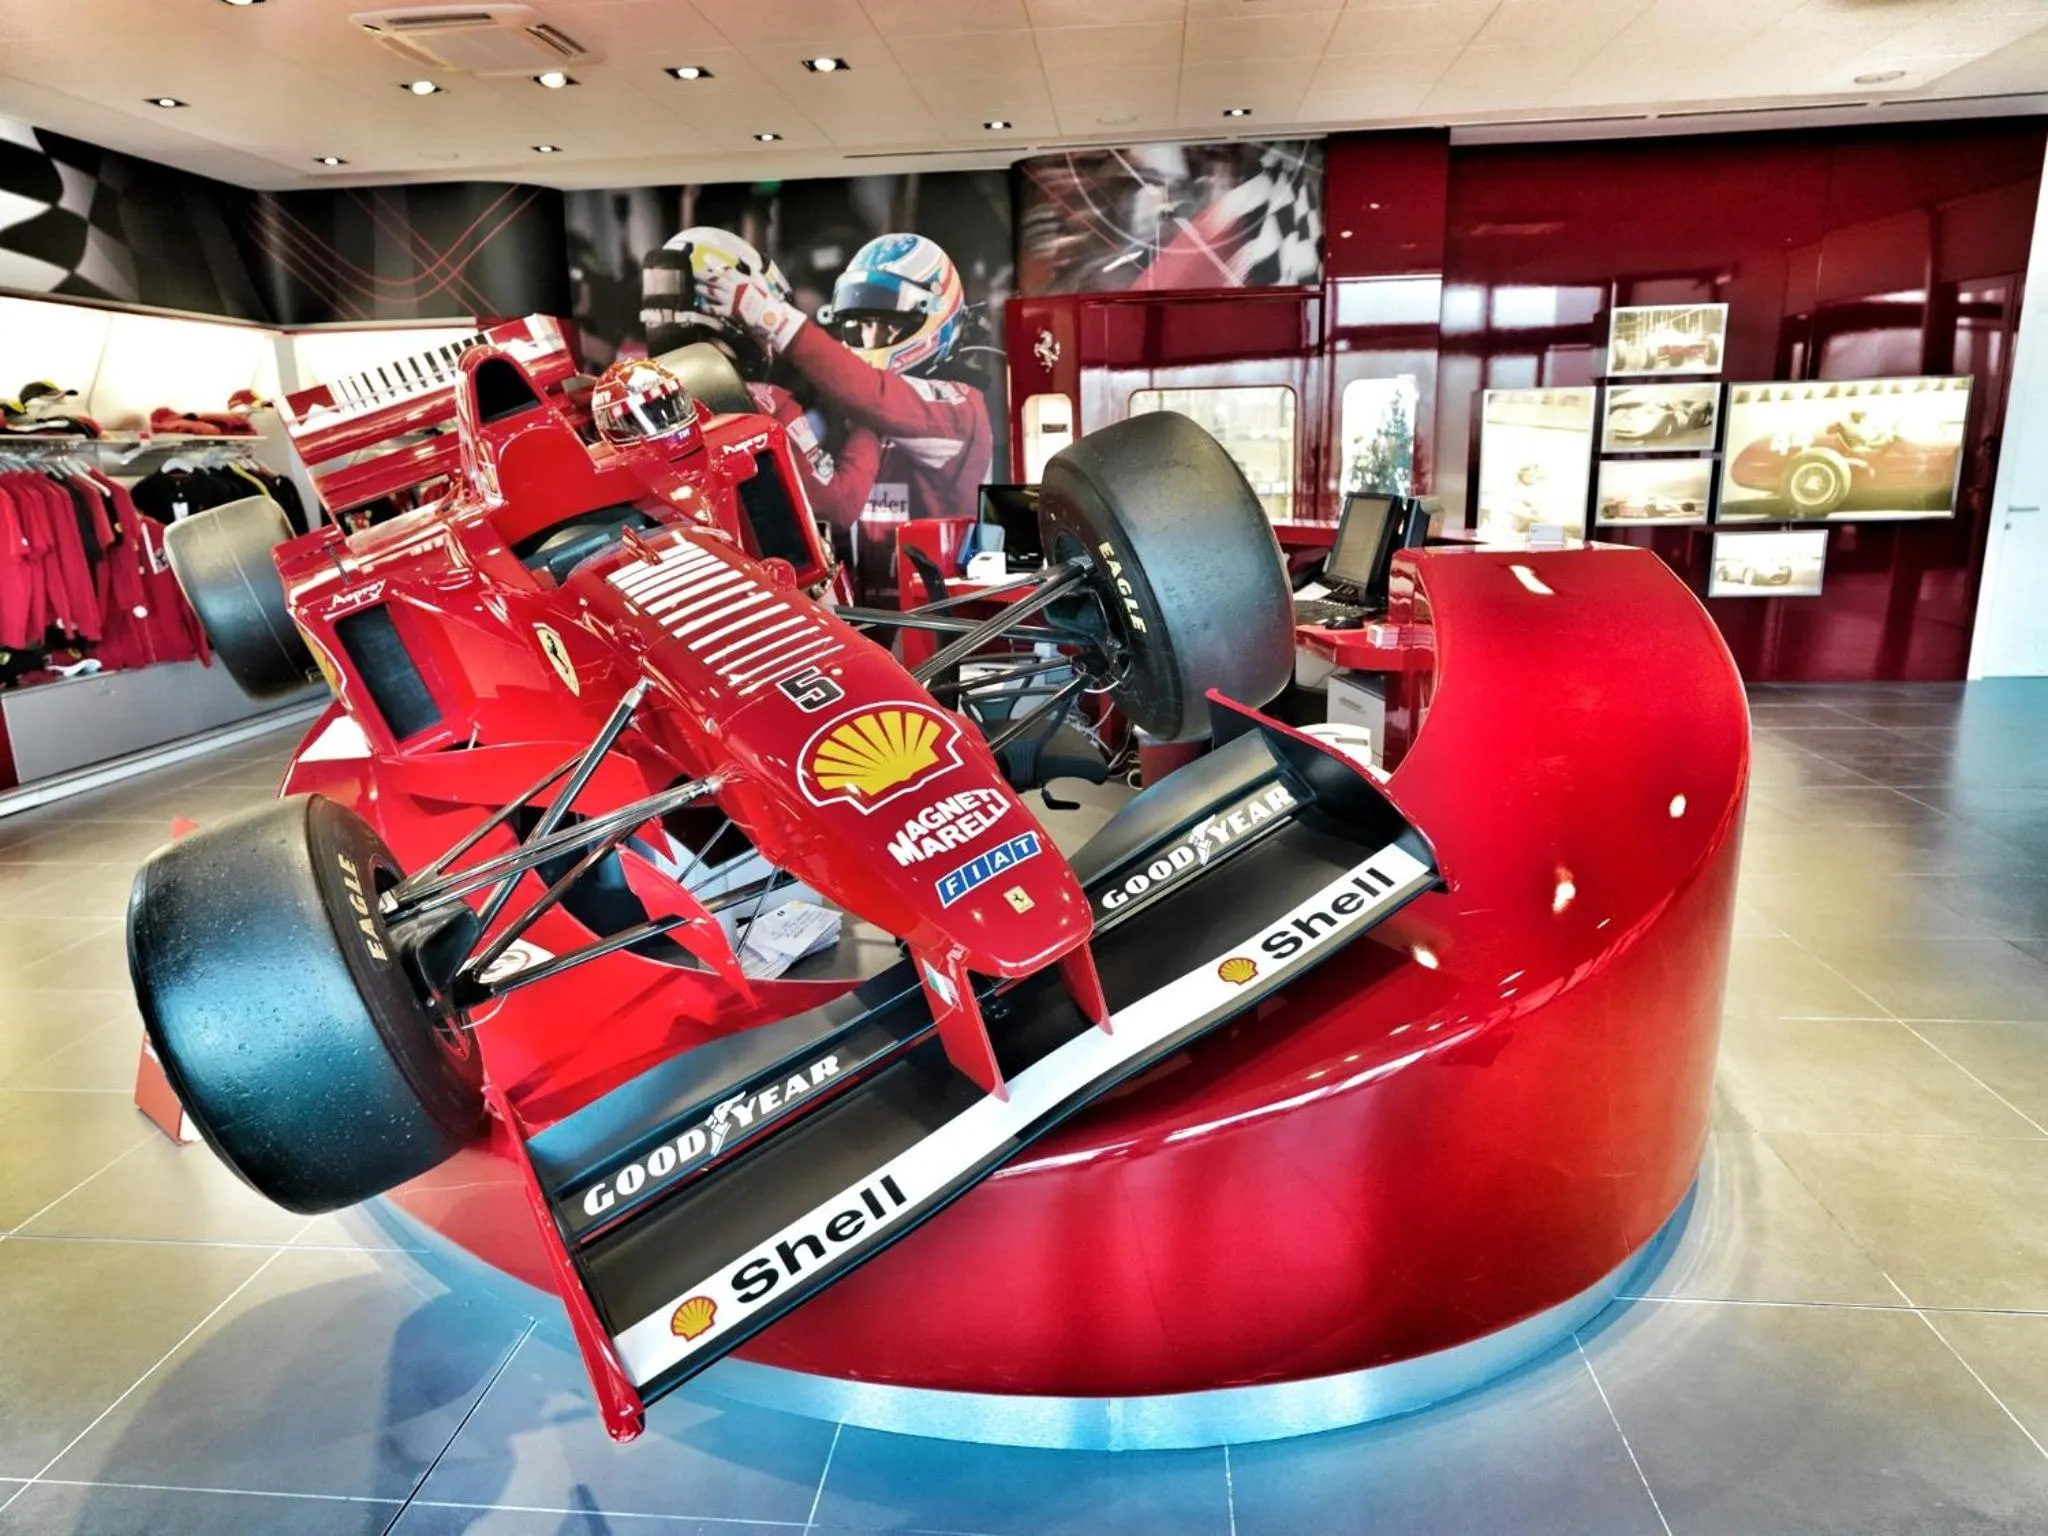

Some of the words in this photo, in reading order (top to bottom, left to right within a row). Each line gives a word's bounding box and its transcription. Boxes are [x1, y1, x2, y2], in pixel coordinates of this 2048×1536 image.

[1099, 542, 1147, 633] EAGLE
[775, 665, 845, 713] 5
[338, 853, 388, 960] EAGLE
[943, 836, 1031, 898] FIAT
[1261, 867, 1396, 960] Shell
[731, 1174, 908, 1304] Shell
